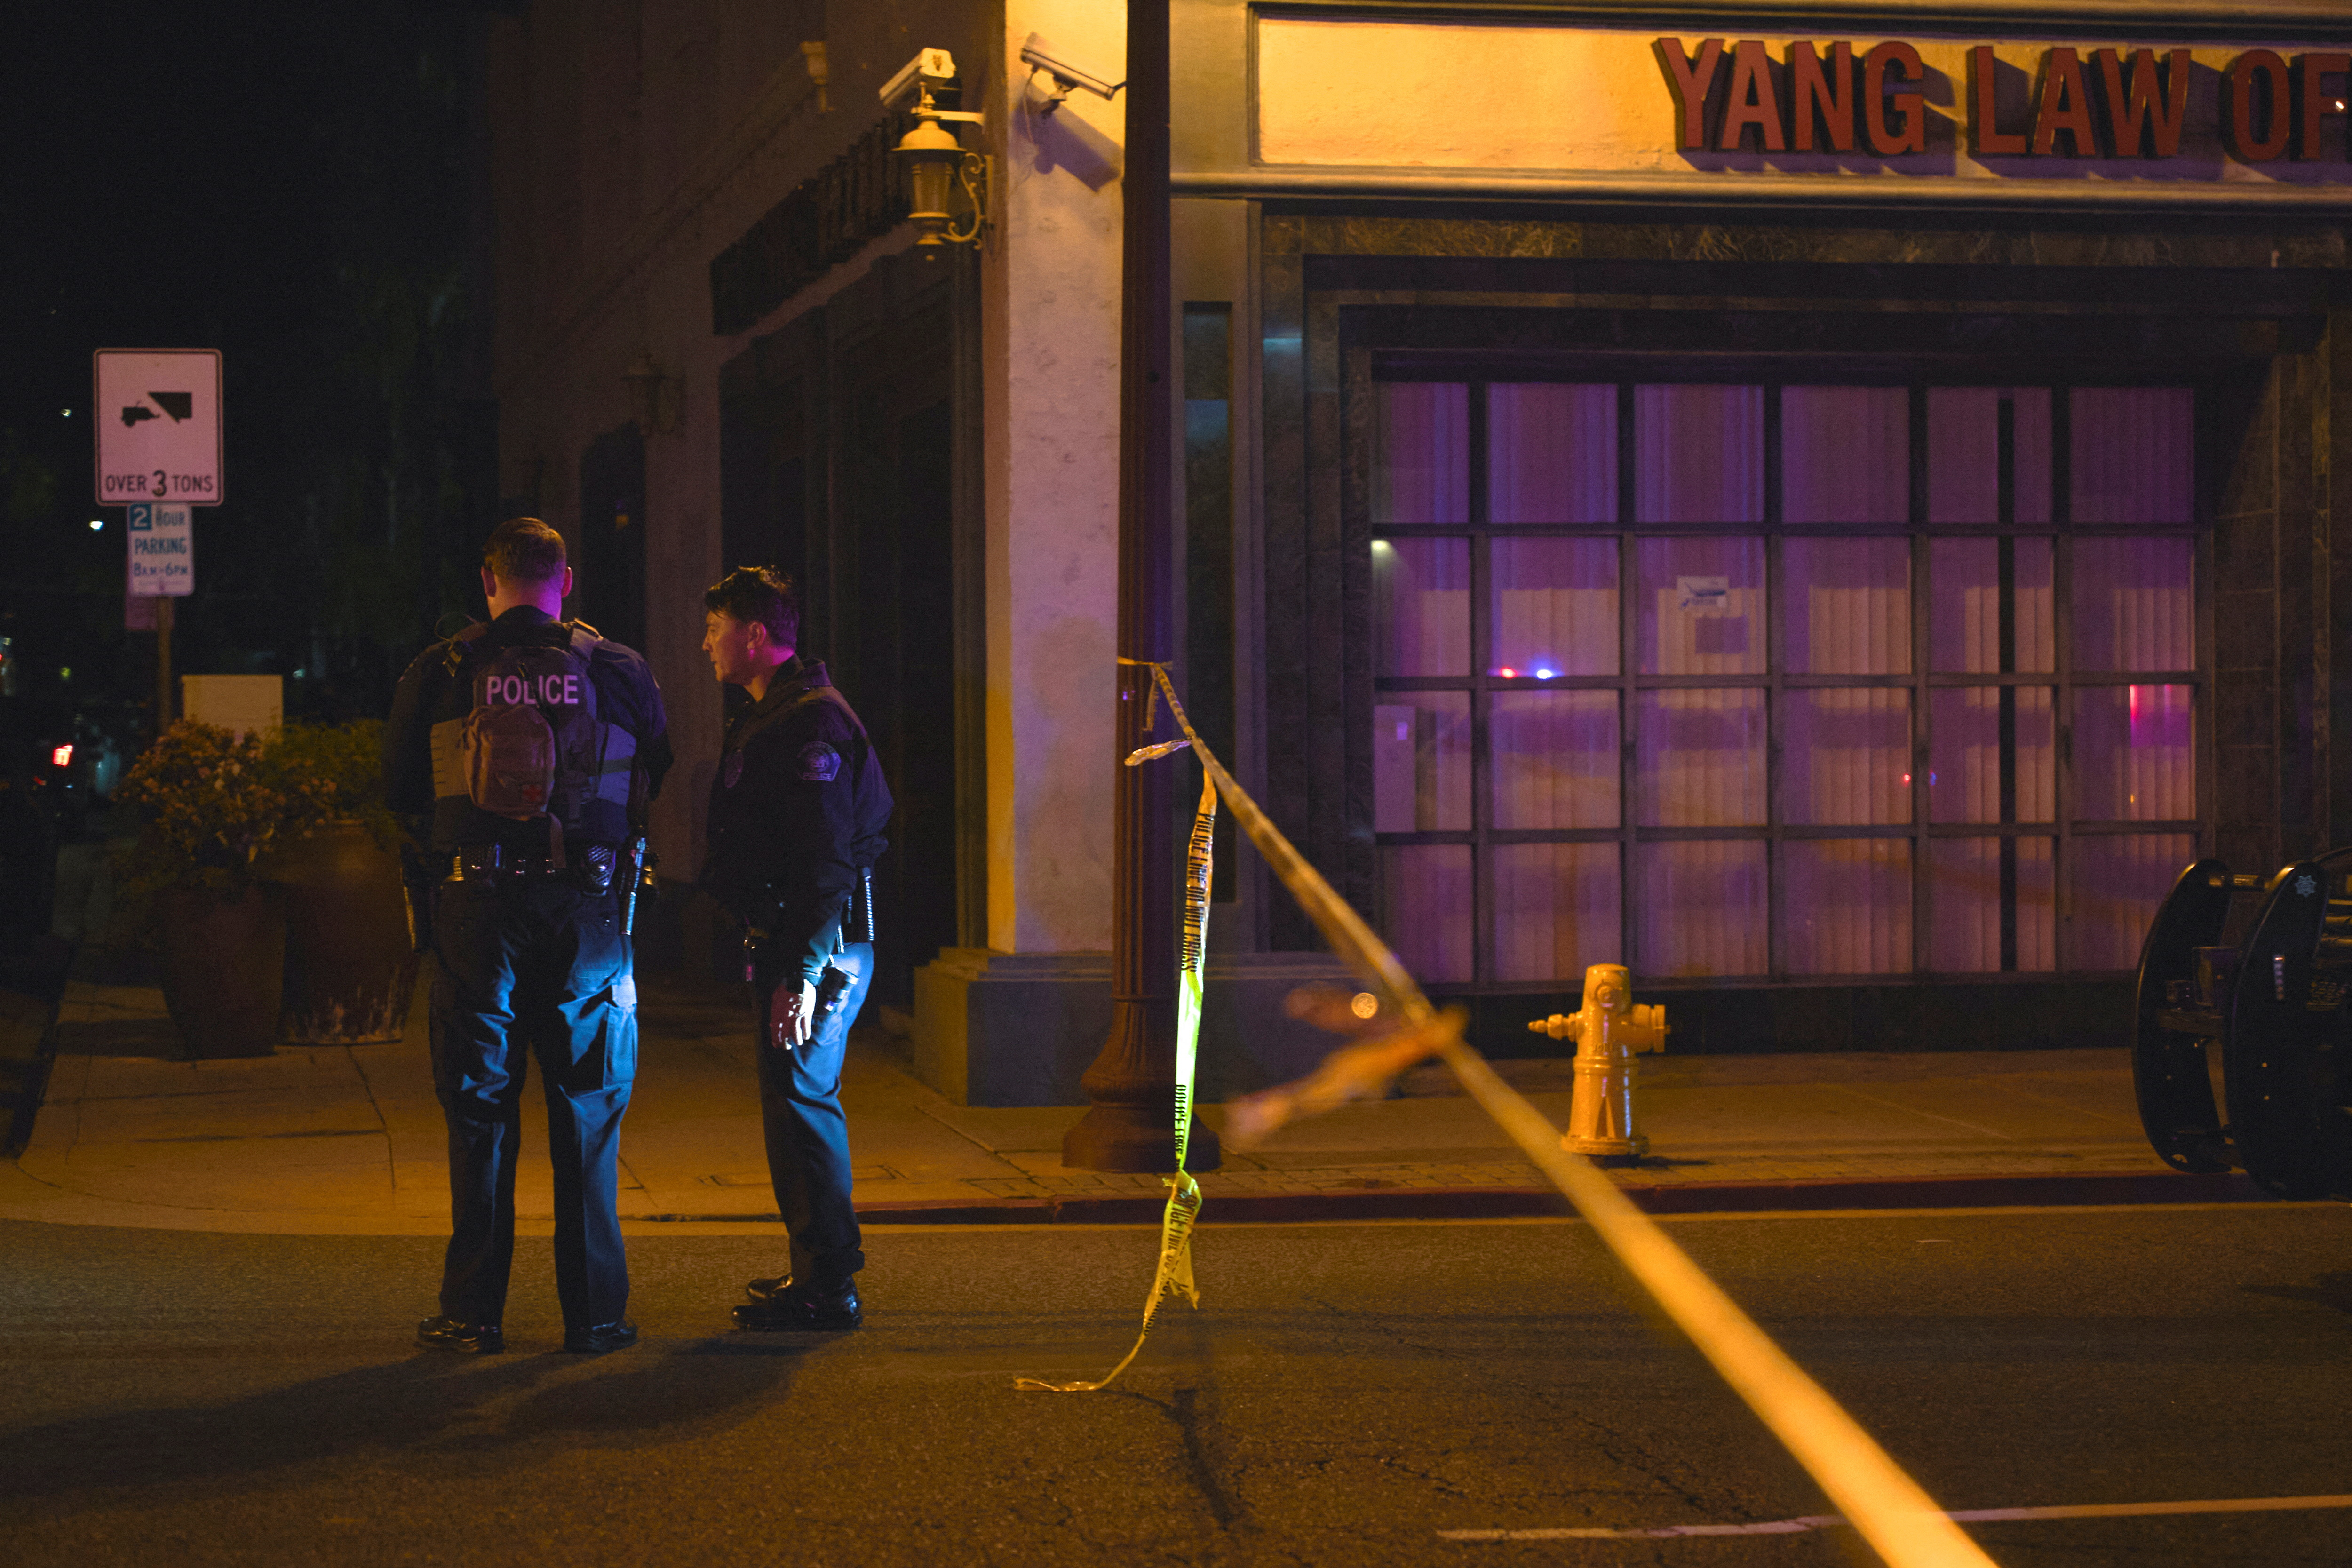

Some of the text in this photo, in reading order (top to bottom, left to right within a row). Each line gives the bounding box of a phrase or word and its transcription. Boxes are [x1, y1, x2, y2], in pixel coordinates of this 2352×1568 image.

[1653, 36, 2352, 161] YANG LAW OF
[106, 470, 214, 497] OVER 3 TONS
[134, 506, 185, 527] 2 HOUR
[135, 537, 187, 555] PARKING
[486, 674, 579, 705] POLICE
[1192, 812, 1215, 853] POLICE
[1187, 886, 1206, 902] DO
[1185, 905, 1204, 928] NOT
[1181, 934, 1201, 973] CROSS
